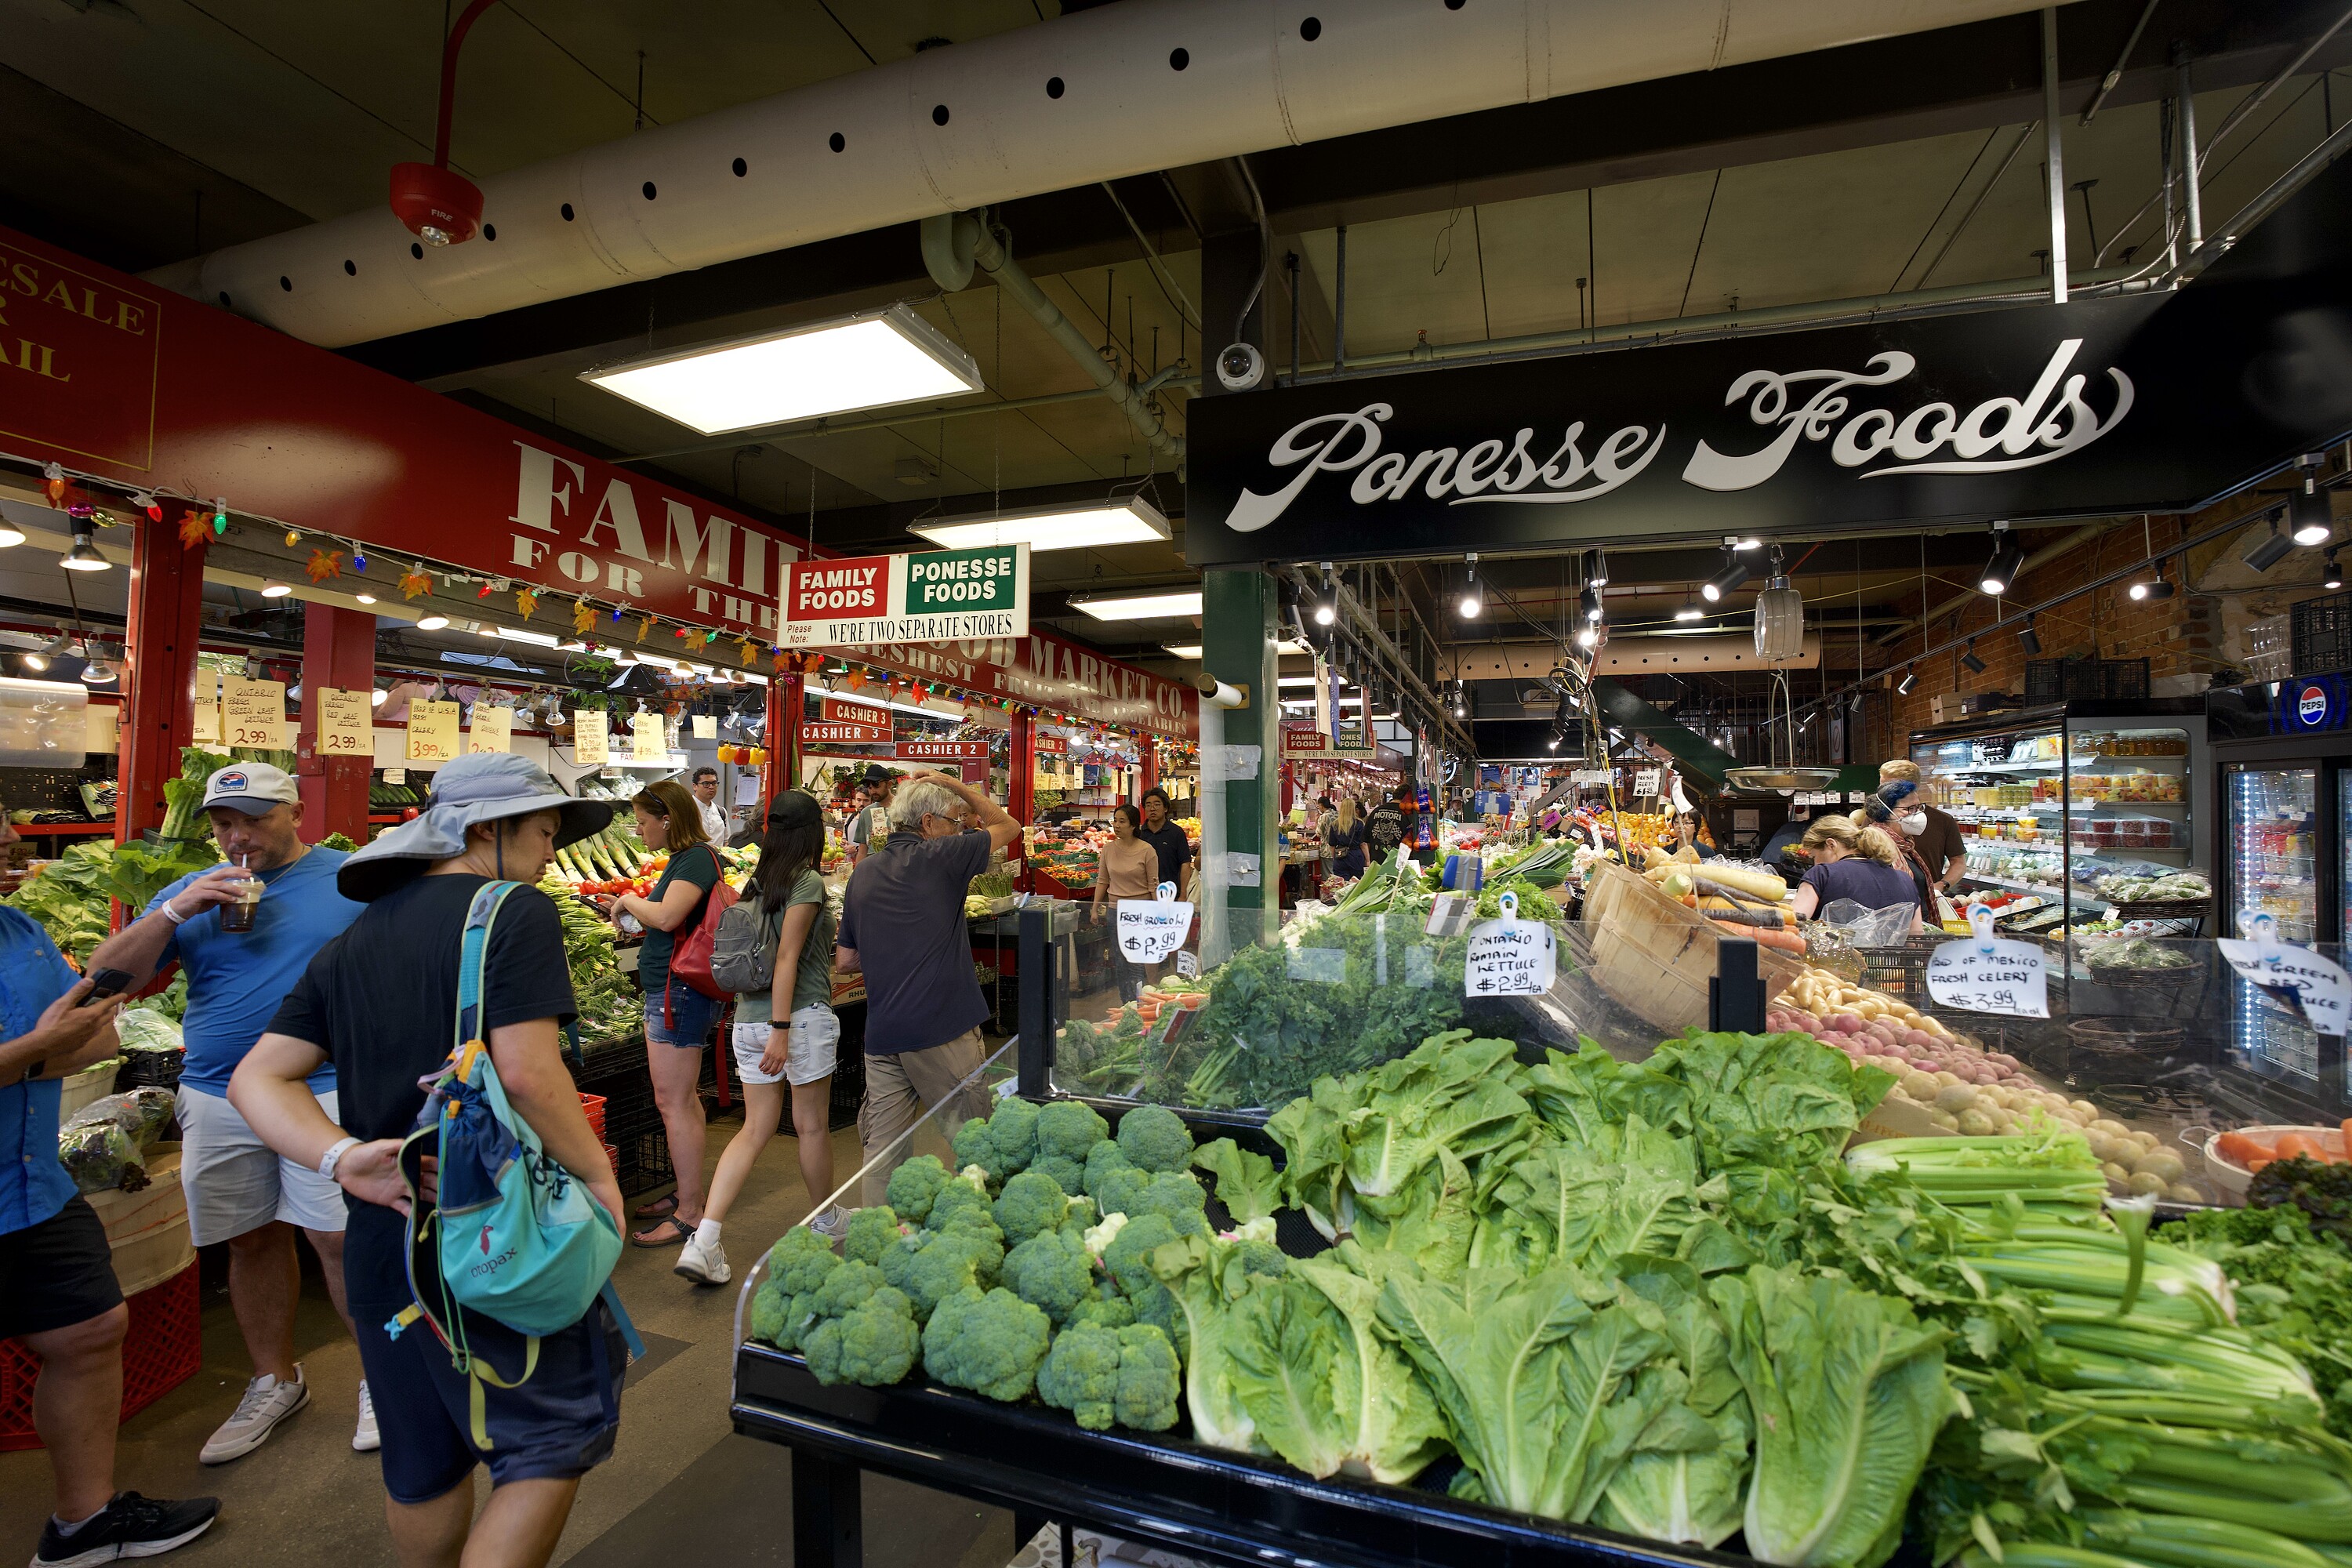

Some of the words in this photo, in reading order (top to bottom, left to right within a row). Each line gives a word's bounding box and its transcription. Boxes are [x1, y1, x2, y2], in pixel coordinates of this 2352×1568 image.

[431, 209, 453, 222] FIRE
[0, 256, 145, 336] SALE
[1225, 402, 1667, 533] Ponesse
[1681, 338, 2134, 492] Foods
[508, 440, 827, 600] FAMI
[800, 567, 877, 590] FAMILY
[911, 557, 1011, 583] PONESSE
[509, 533, 646, 598] FOR
[688, 584, 777, 630] THE
[924, 580, 996, 603] FOODS
[799, 589, 876, 611] FOODS
[787, 624, 811, 634] Please
[829, 622, 864, 644] WE'RE
[869, 620, 895, 641] TWO
[898, 616, 960, 640] SEPARATE
[964, 613, 1012, 637] STORES
[789, 635, 809, 644] Note:
[1029, 633, 1151, 710] MARKET
[1156, 682, 1188, 720] CO.
[844, 643, 975, 683] ESHEST
[993, 672, 1056, 702] FRUIT
[1113, 706, 1188, 735] VEGETABLES
[228, 706, 253, 715] GREEN
[837, 704, 878, 724] CASHIER
[880, 712, 886, 724] 3
[2301, 701, 2324, 711] PEPSI
[802, 727, 862, 739] CASHIER
[872, 728, 879, 739] 3
[908, 744, 962, 755] CASHIER
[971, 744, 976, 755] 2
[1035, 739, 1055, 750] ASHIER
[1058, 742, 1063, 750] 2
[1374, 811, 1402, 821] MOTORI
[1120, 912, 1142, 922] FRESH
[1987, 954, 2038, 967] MEXICO
[1930, 973, 1968, 984] FRESH
[1978, 972, 2031, 983] CELERY
[2270, 963, 2338, 985] GREEN
